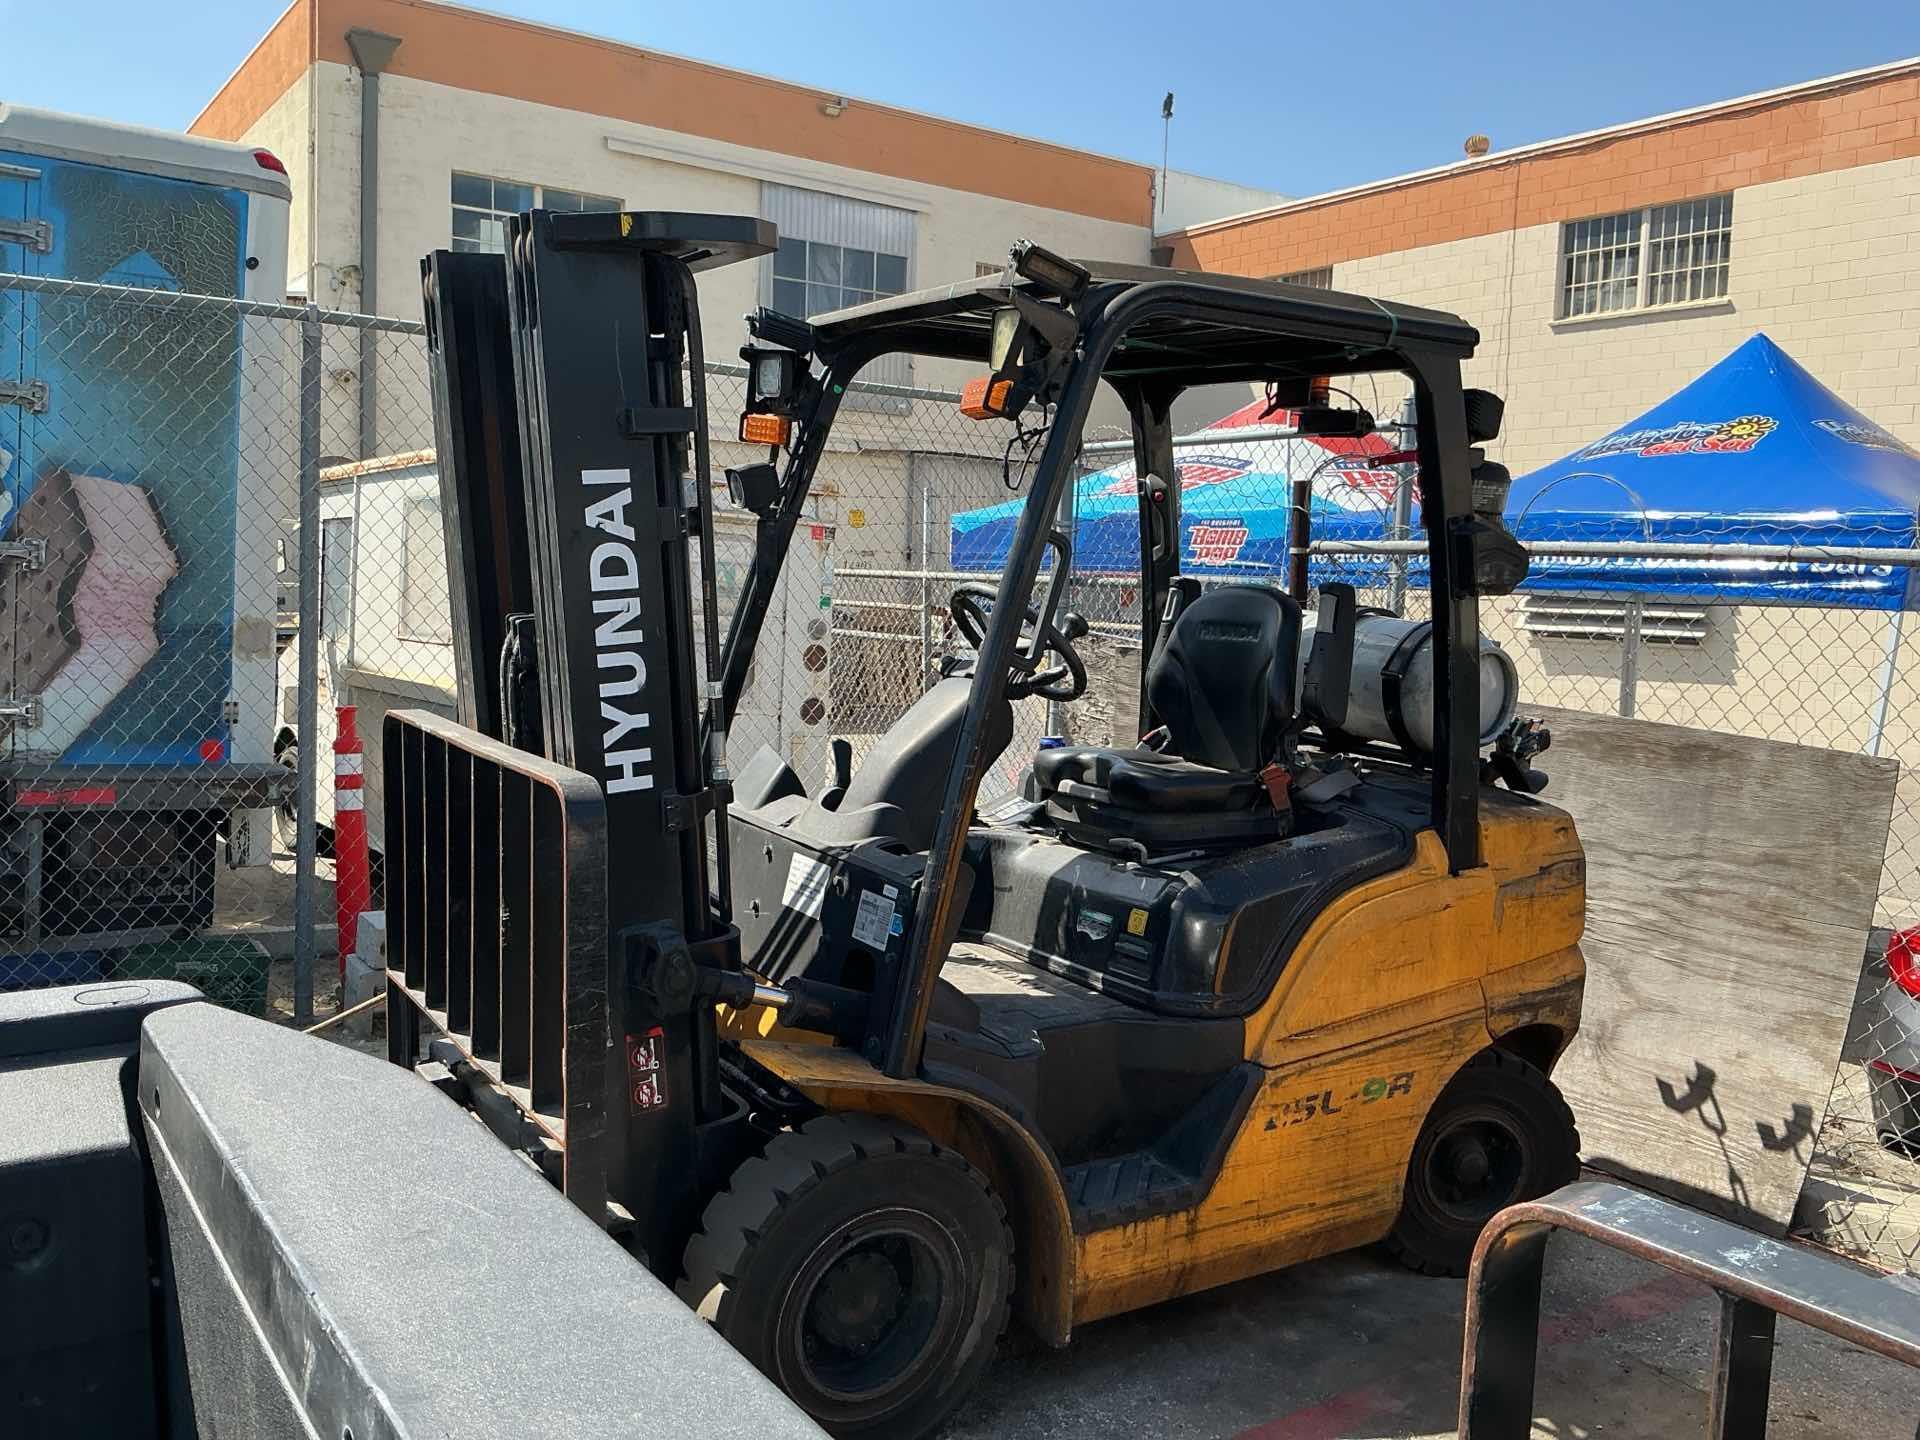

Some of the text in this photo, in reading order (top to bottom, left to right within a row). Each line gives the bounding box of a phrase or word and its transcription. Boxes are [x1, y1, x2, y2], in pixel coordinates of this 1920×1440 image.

[1640, 435, 1756, 457] del Sol
[580, 468, 654, 794] HYUNDAI
